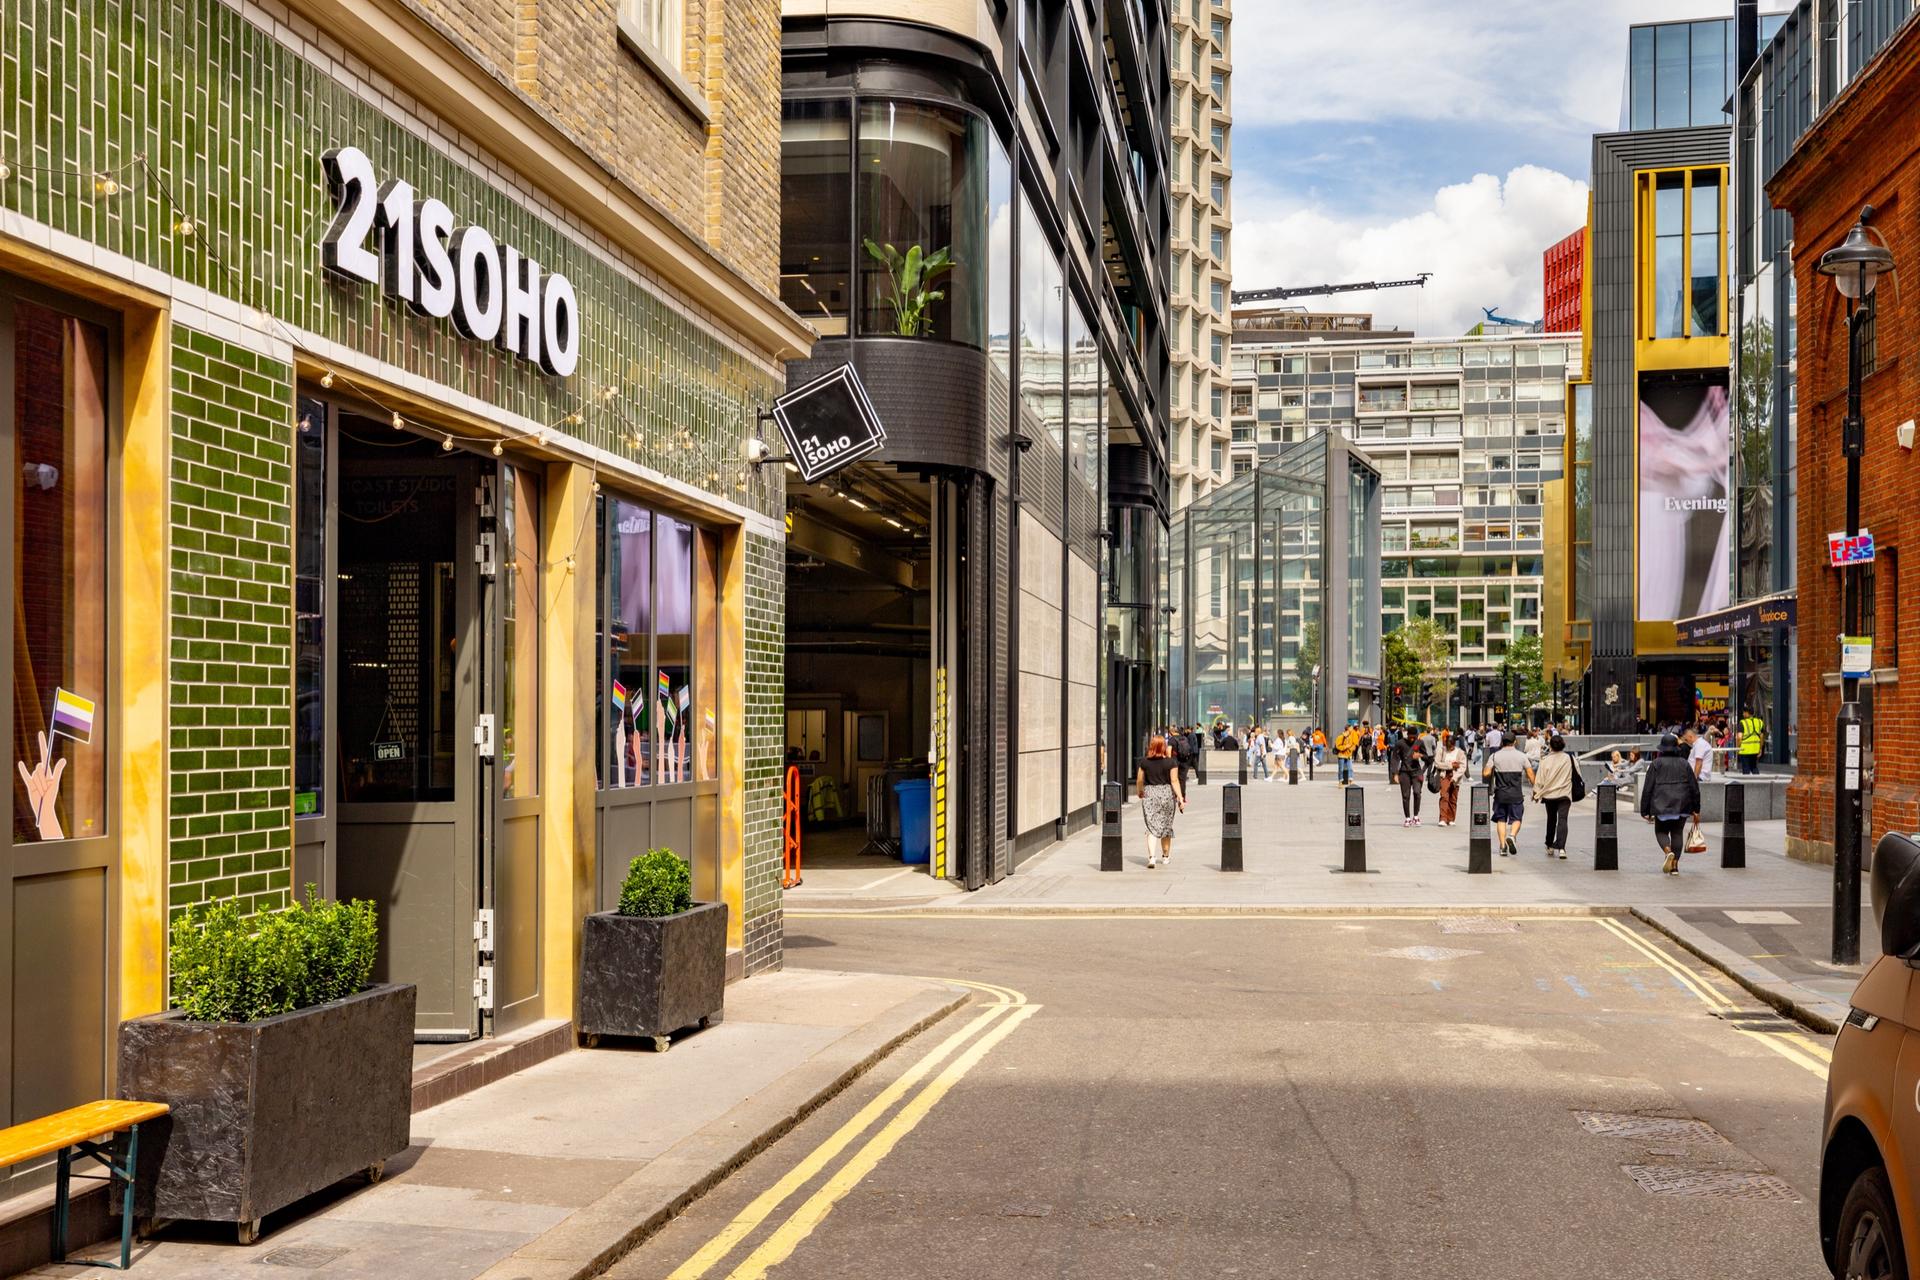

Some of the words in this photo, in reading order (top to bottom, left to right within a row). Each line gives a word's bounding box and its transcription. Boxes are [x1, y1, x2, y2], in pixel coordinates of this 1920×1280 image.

[324, 146, 580, 377] 21SOHO
[801, 435, 821, 453] 21
[807, 435, 851, 465] SOHO
[1663, 495, 1728, 514] Evening
[378, 747, 400, 759] OPEN
